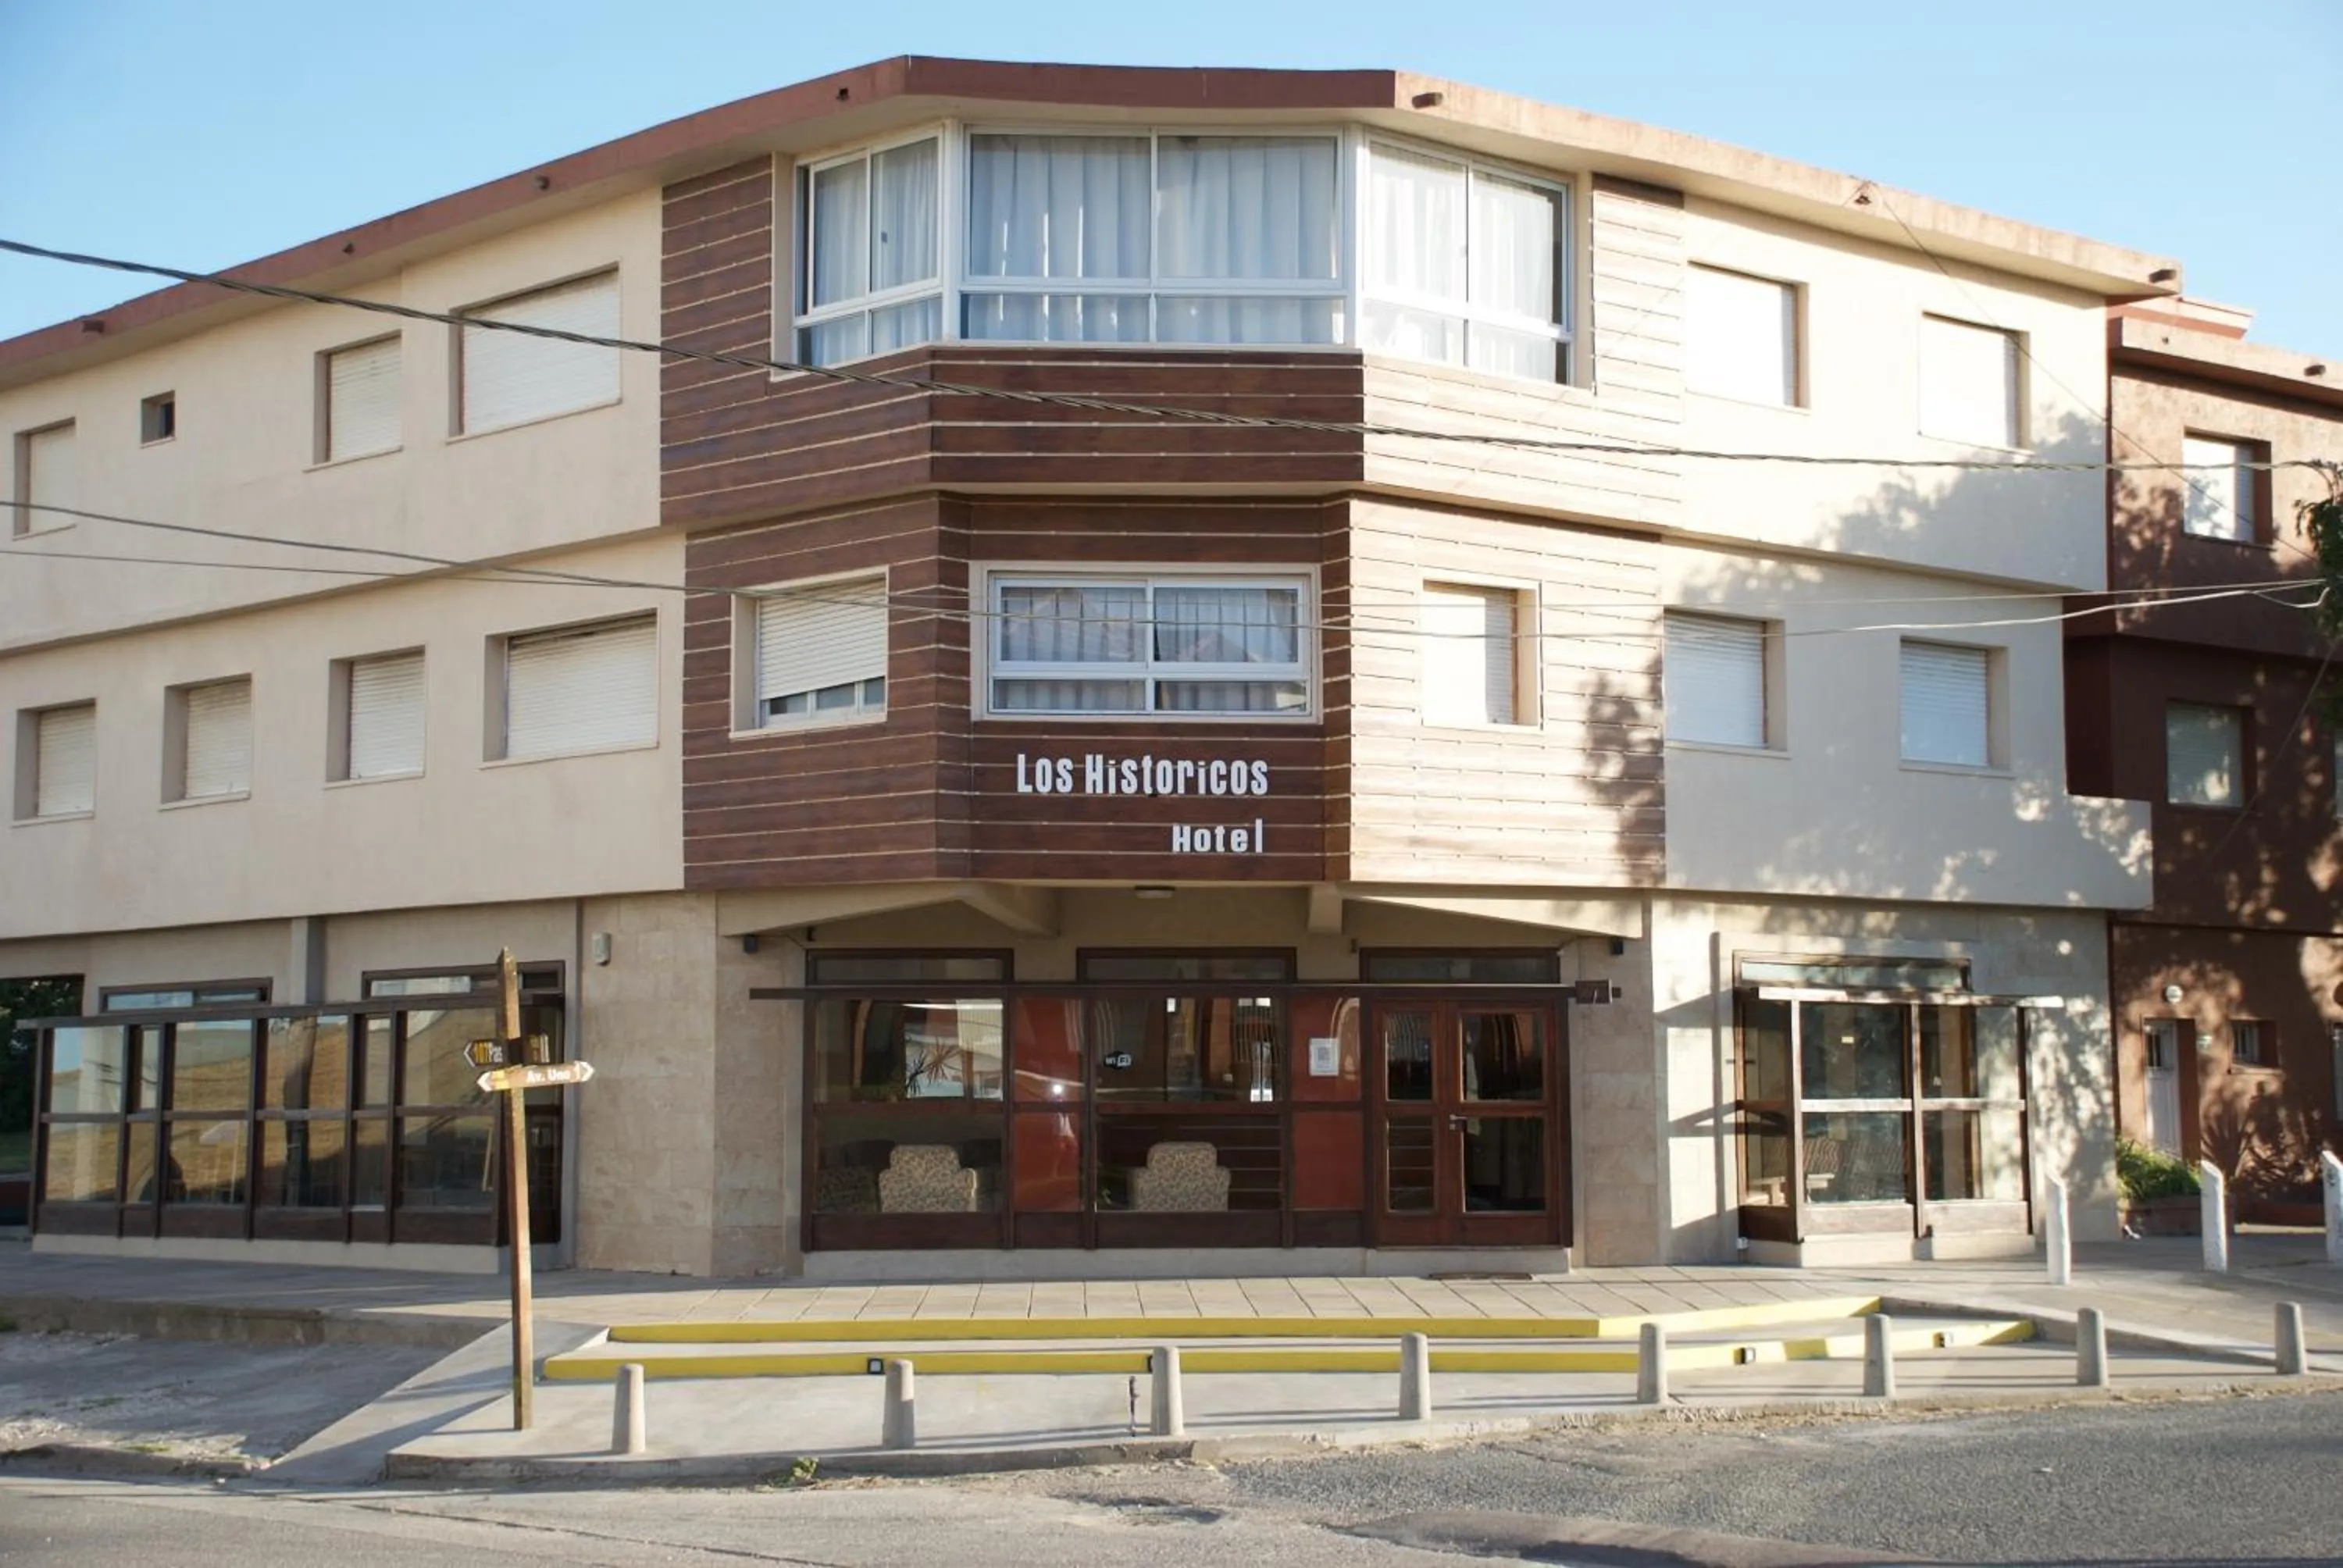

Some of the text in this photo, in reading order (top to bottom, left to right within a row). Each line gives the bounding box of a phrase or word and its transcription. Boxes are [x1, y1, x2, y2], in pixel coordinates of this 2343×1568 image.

[1018, 754, 1268, 796] Los Historicos
[1172, 818, 1263, 853] Hotel
